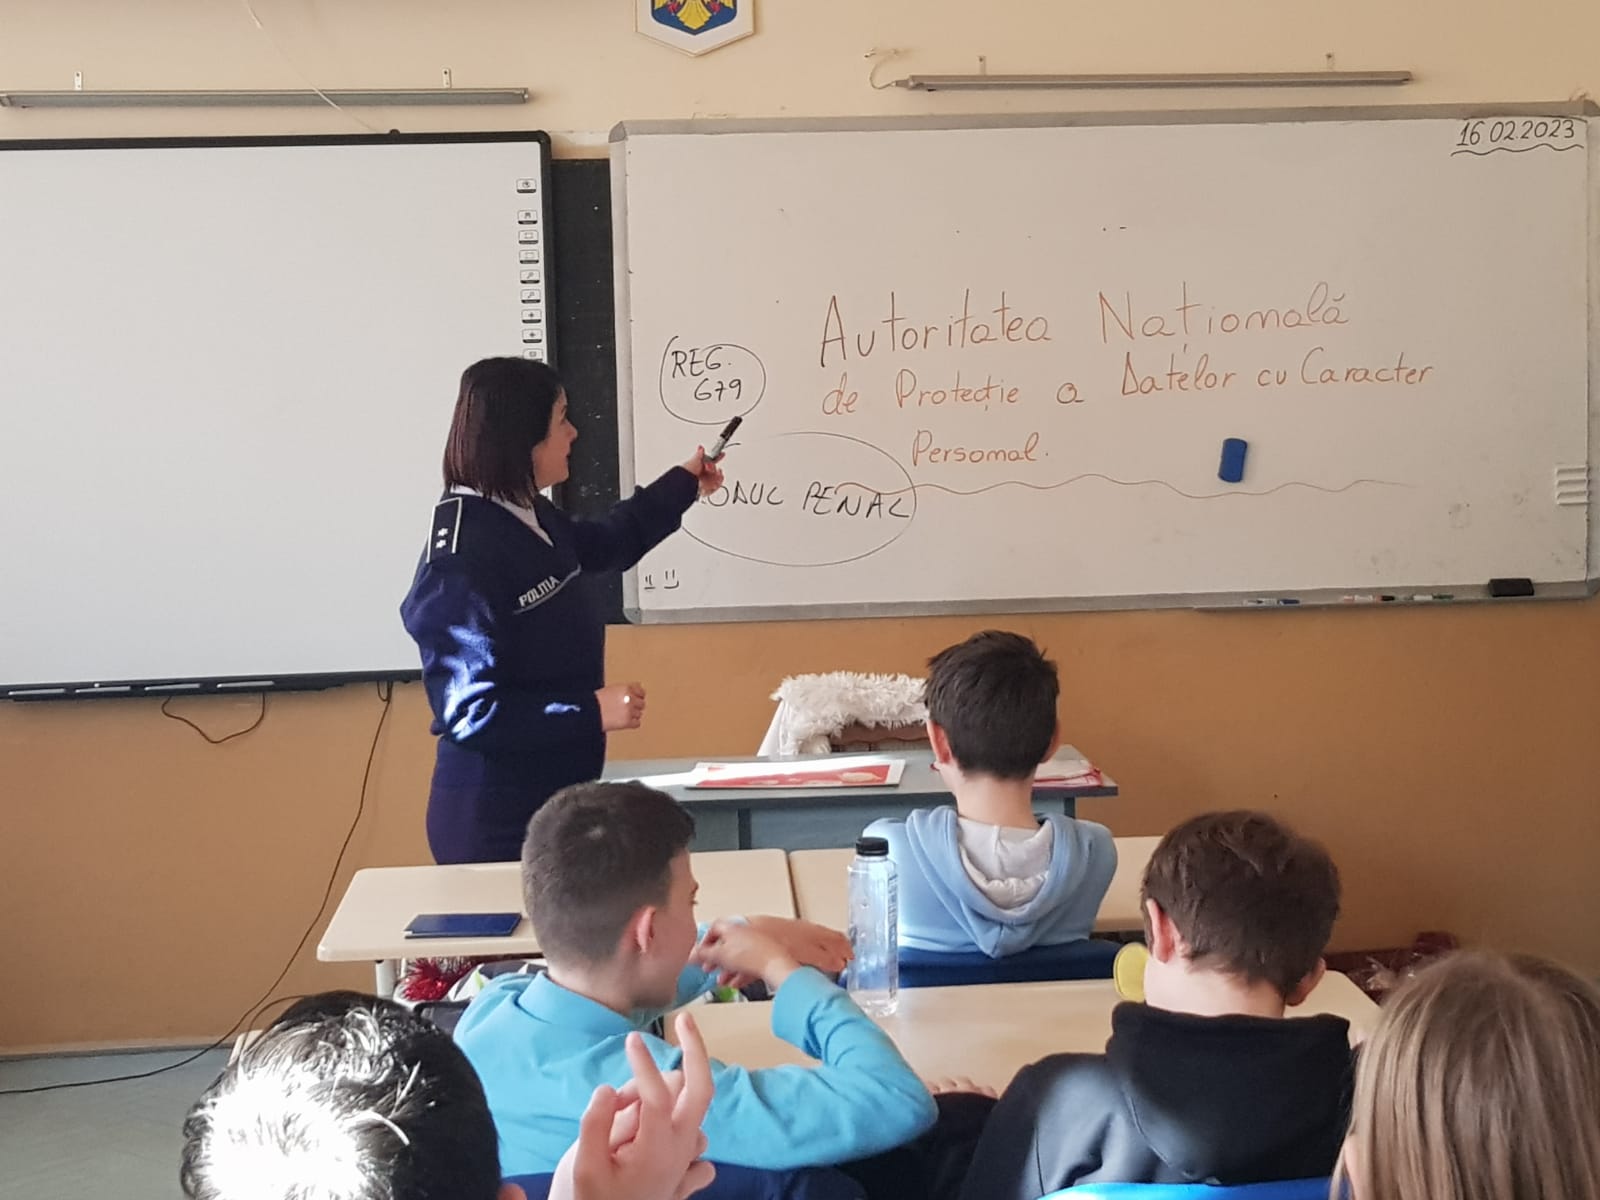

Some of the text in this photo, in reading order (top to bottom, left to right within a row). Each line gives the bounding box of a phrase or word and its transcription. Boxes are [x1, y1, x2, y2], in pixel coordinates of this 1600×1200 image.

[820, 288, 1051, 367] Autoritatea
[821, 346, 1434, 415] de Protecție a Datelor cu Caracter
[698, 480, 784, 506] ODUL
